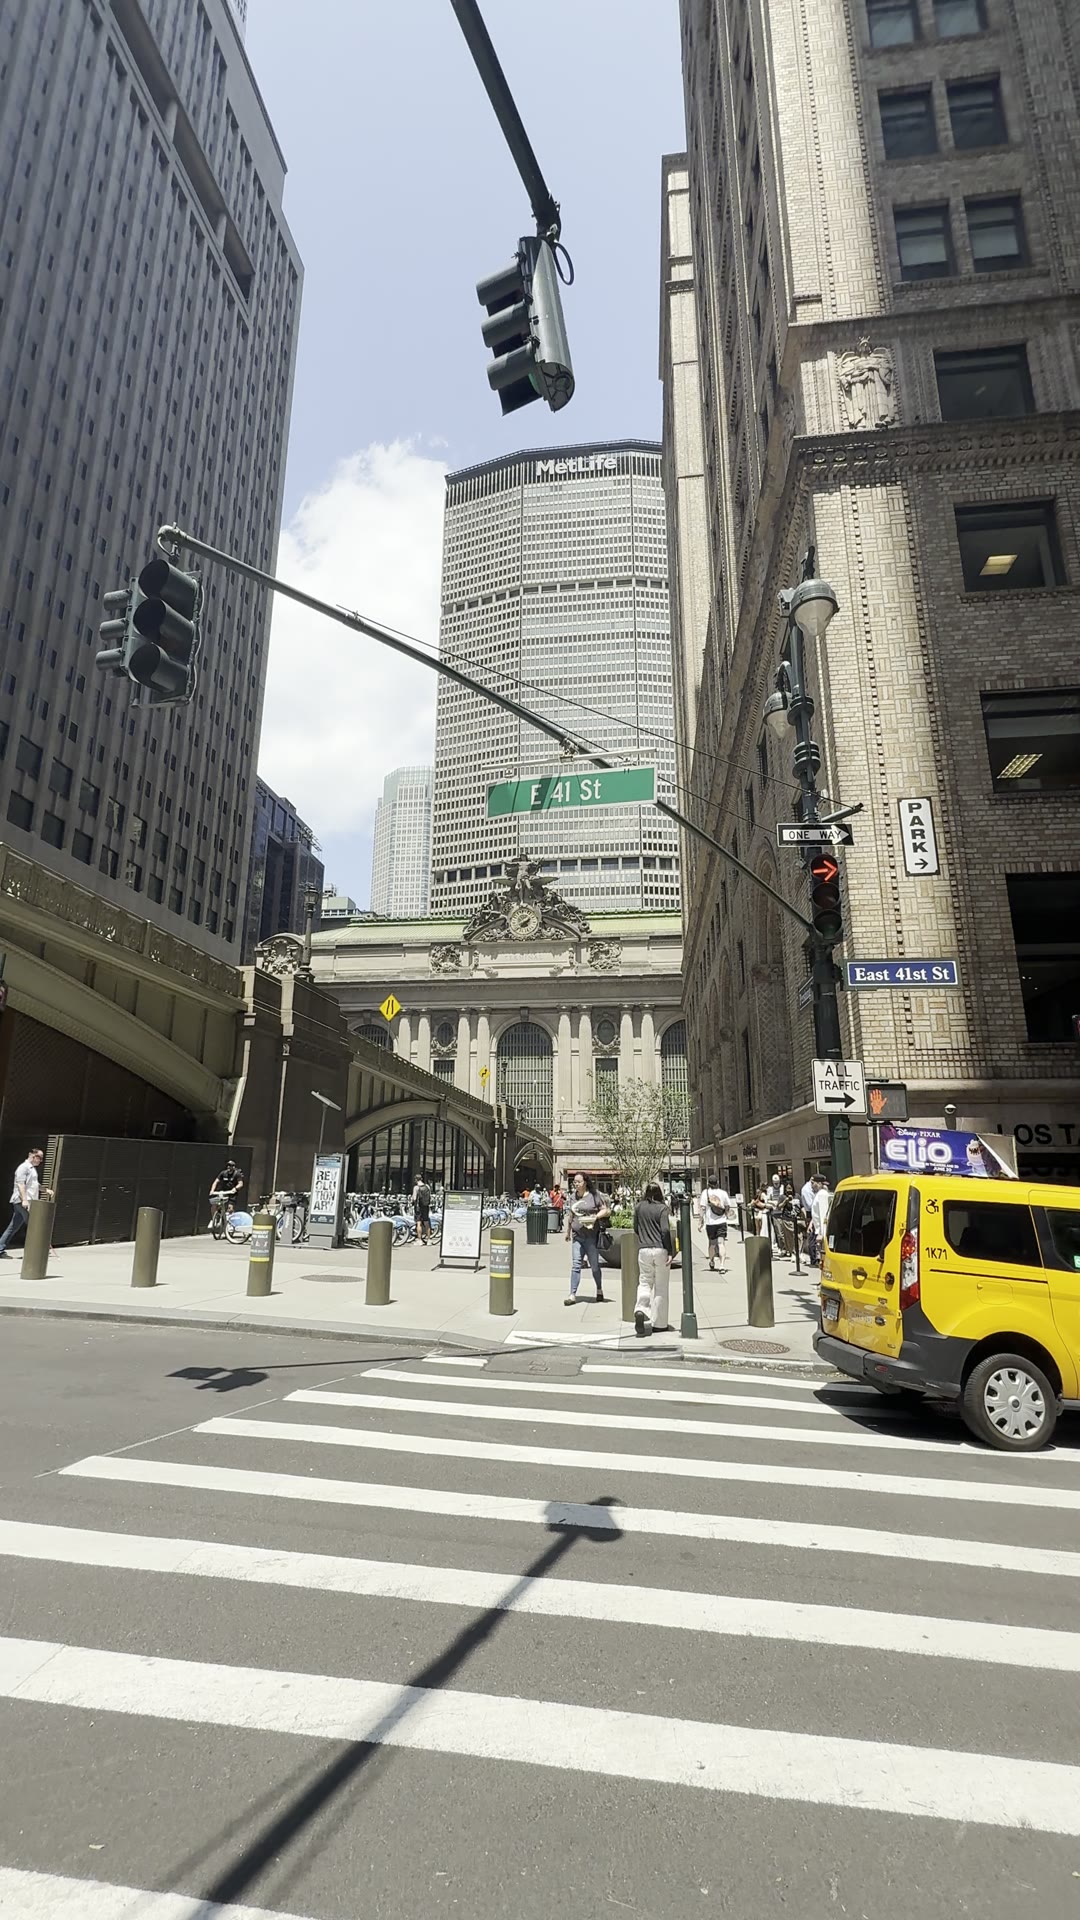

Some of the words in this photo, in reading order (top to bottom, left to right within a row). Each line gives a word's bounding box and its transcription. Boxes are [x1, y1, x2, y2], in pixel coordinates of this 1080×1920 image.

[536, 454, 617, 476] MetLife
[530, 784, 542, 805] E
[551, 781, 571, 803] 41
[579, 778, 602, 801] St
[788, 830, 810, 840] ONE
[819, 830, 842, 840] WAY
[907, 802, 929, 854] PARK
[854, 967, 890, 981] East
[895, 967, 928, 981] 41st
[931, 966, 950, 980] St
[824, 1063, 853, 1077] ALL
[818, 1080, 860, 1091] TRAFFIC
[895, 1128, 917, 1139] Disney
[920, 1130, 941, 1138] PIXAR
[1058, 1123, 1080, 1145] T
[925, 1247, 948, 1260] 1K71
